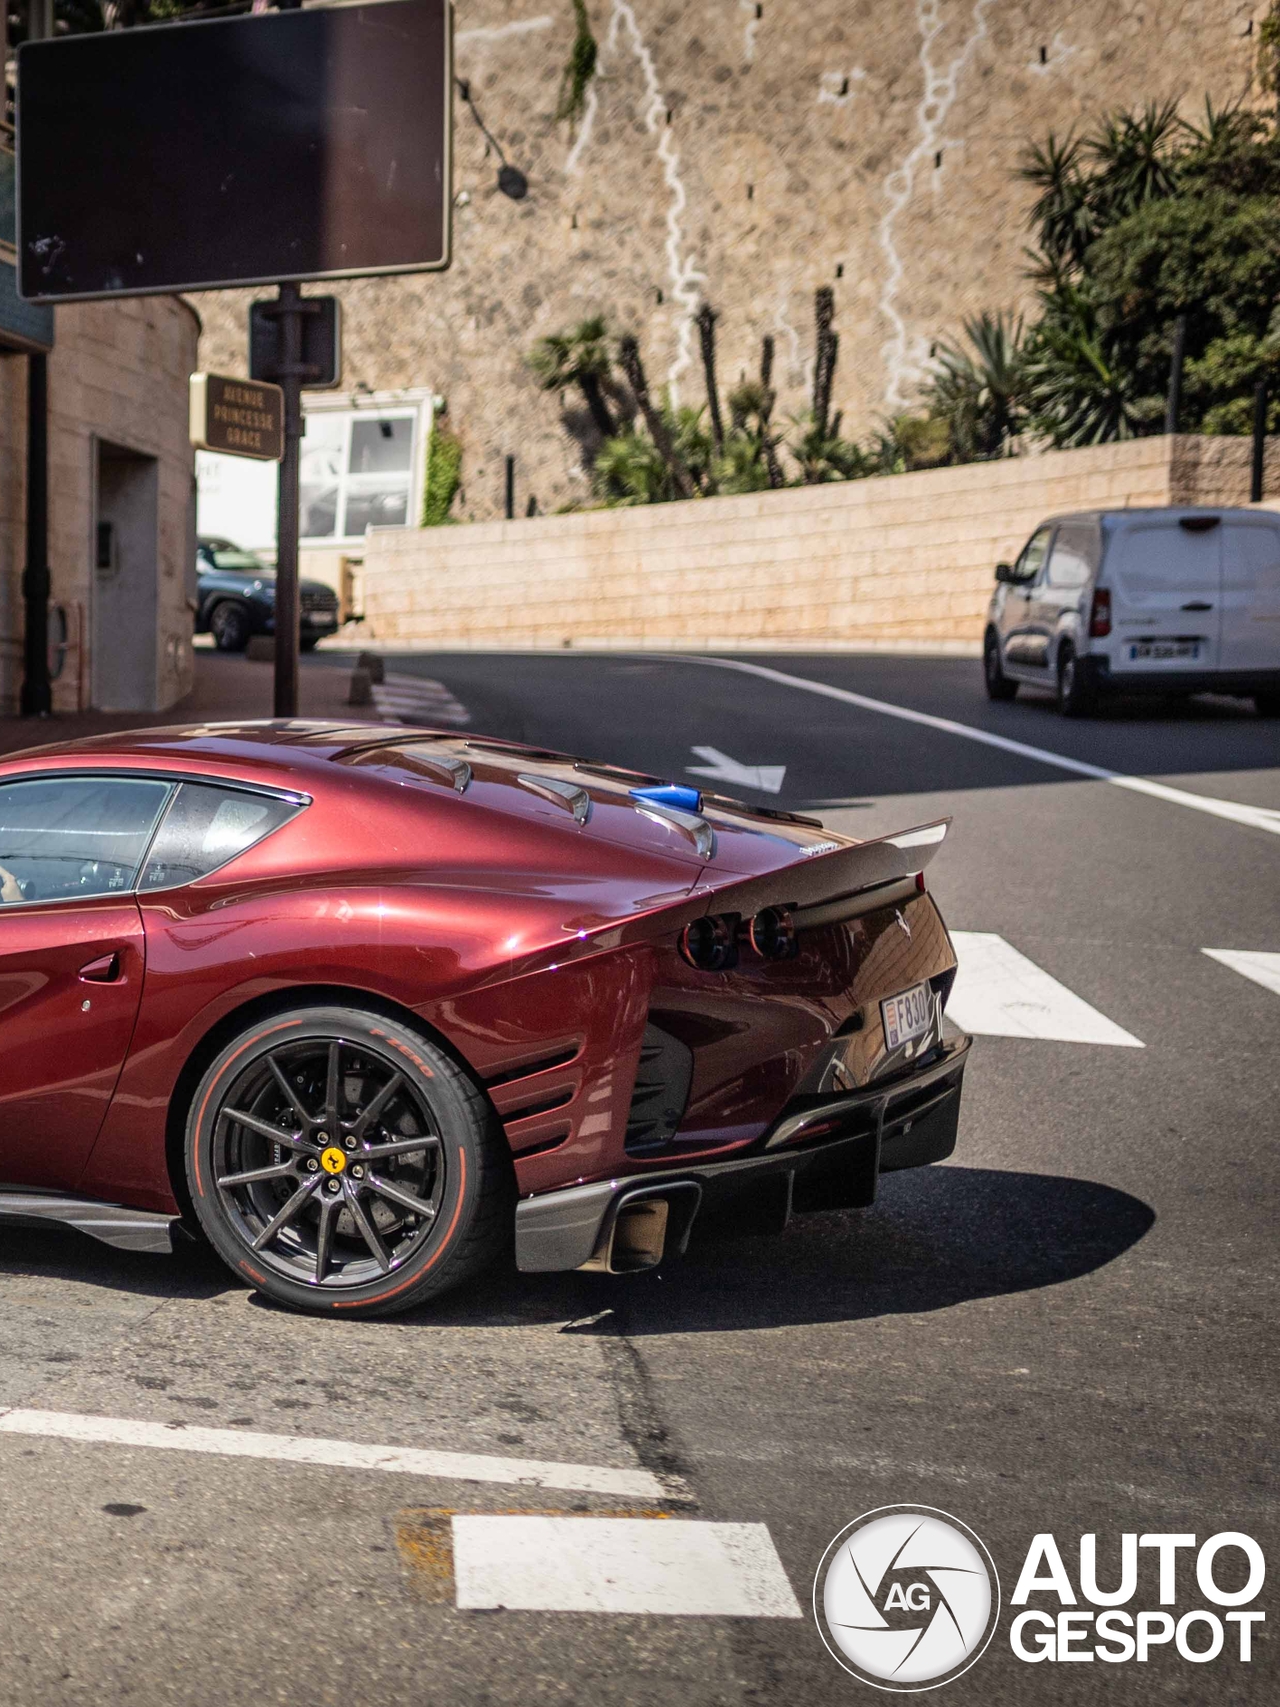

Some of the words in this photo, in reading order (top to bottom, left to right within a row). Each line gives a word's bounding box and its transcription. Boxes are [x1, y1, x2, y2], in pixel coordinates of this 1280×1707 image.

[214, 404, 273, 430] PRINCESSE
[227, 427, 261, 448] GRACE
[897, 989, 926, 1034] F830
[385, 1037, 435, 1077] ZERO
